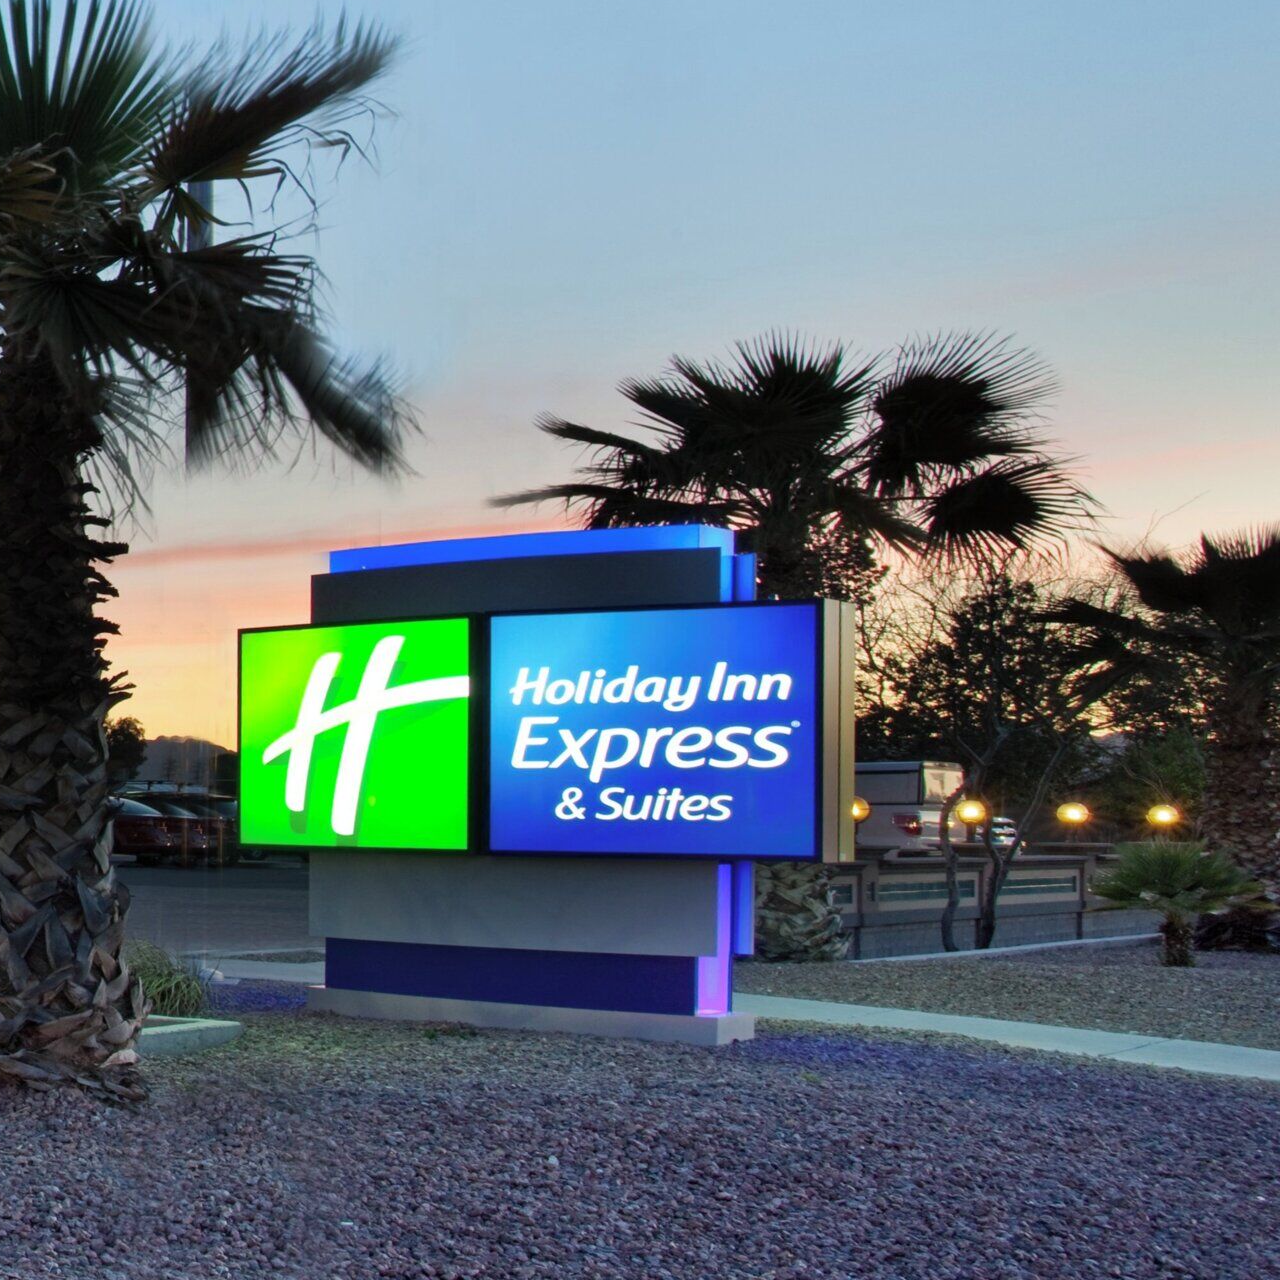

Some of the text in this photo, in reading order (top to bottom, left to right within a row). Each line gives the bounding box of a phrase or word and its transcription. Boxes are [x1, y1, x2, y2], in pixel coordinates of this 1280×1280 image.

[508, 661, 793, 713] Holiday Inn
[510, 715, 792, 784] Express
[554, 786, 733, 822] & Suites
